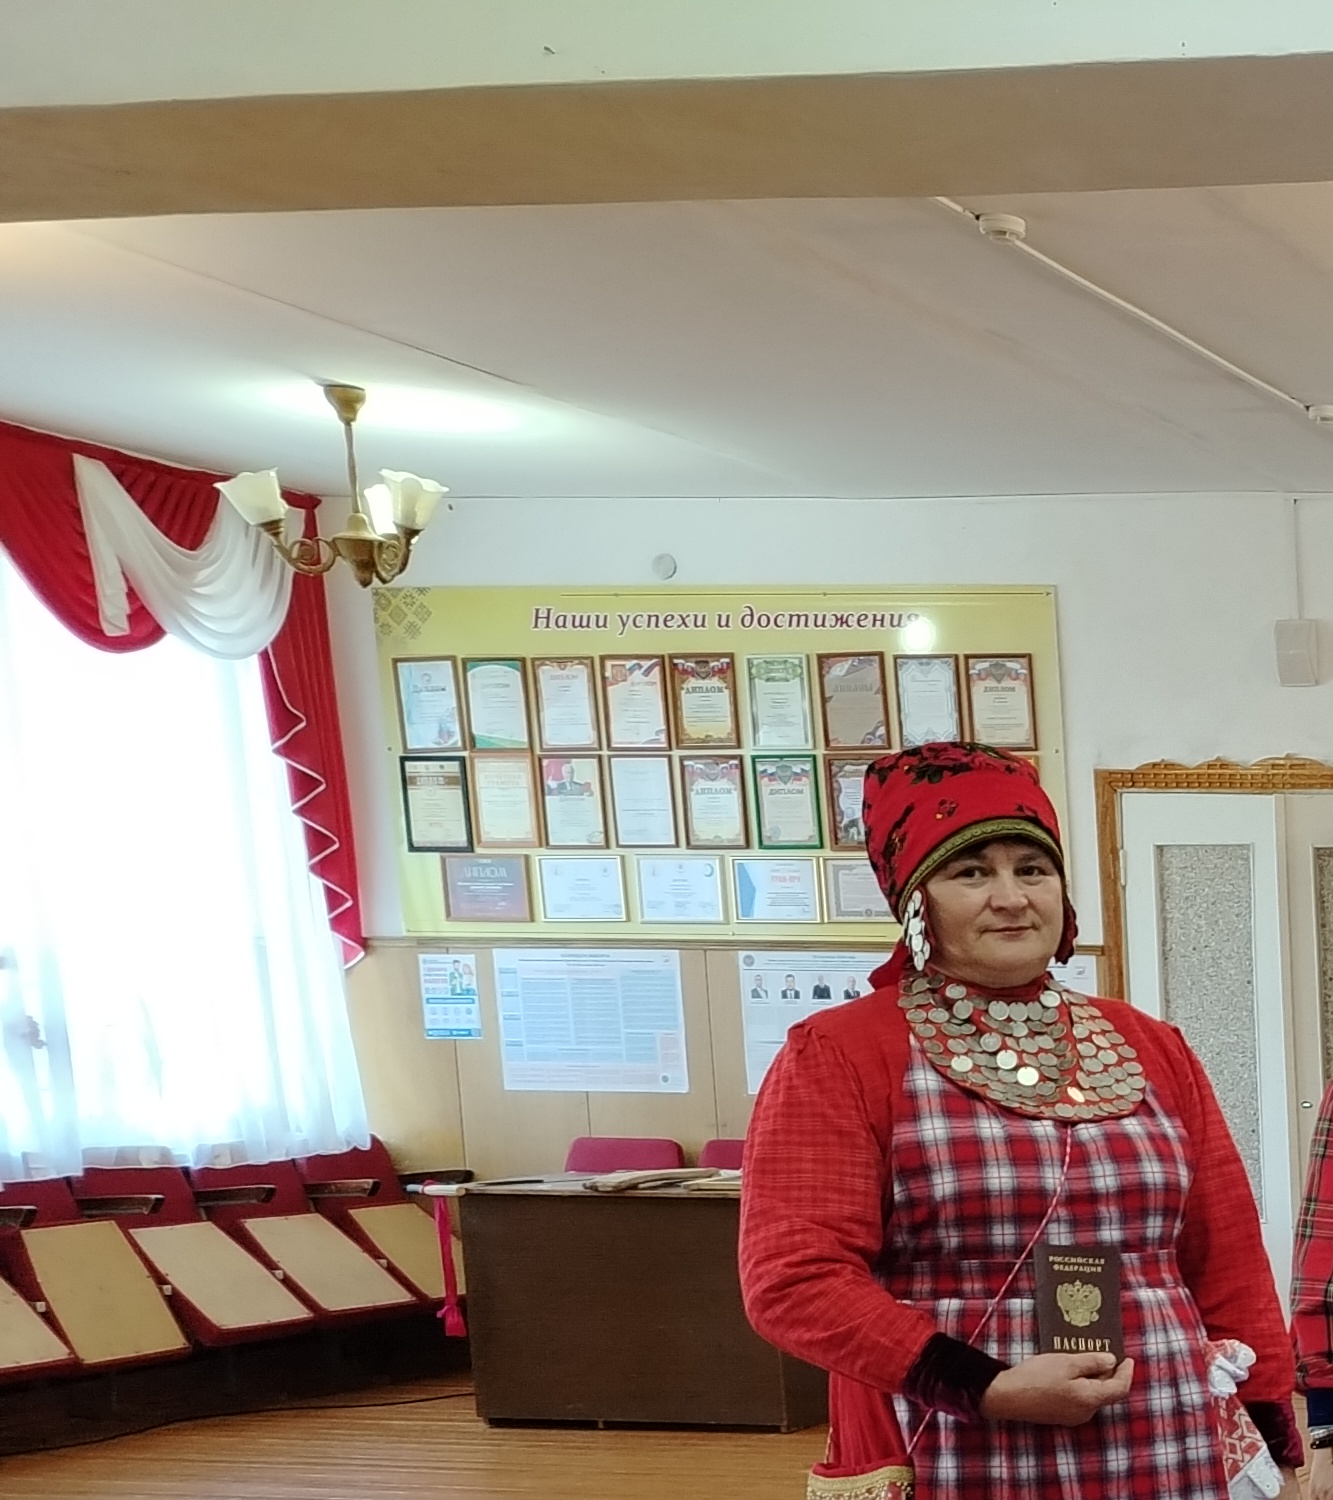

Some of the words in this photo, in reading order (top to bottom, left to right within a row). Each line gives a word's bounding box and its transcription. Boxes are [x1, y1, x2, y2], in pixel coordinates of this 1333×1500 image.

[532, 607, 609, 630] Наши
[616, 612, 707, 635] успехи
[717, 612, 732, 629] и
[685, 685, 724, 695] ДИПЛОМ
[1048, 1255, 1106, 1266] РОССИЙСКАЯ
[1052, 1264, 1103, 1274] ФЕДЕРАЦИЯ
[1053, 1336, 1111, 1352] ПАСПОРТ
